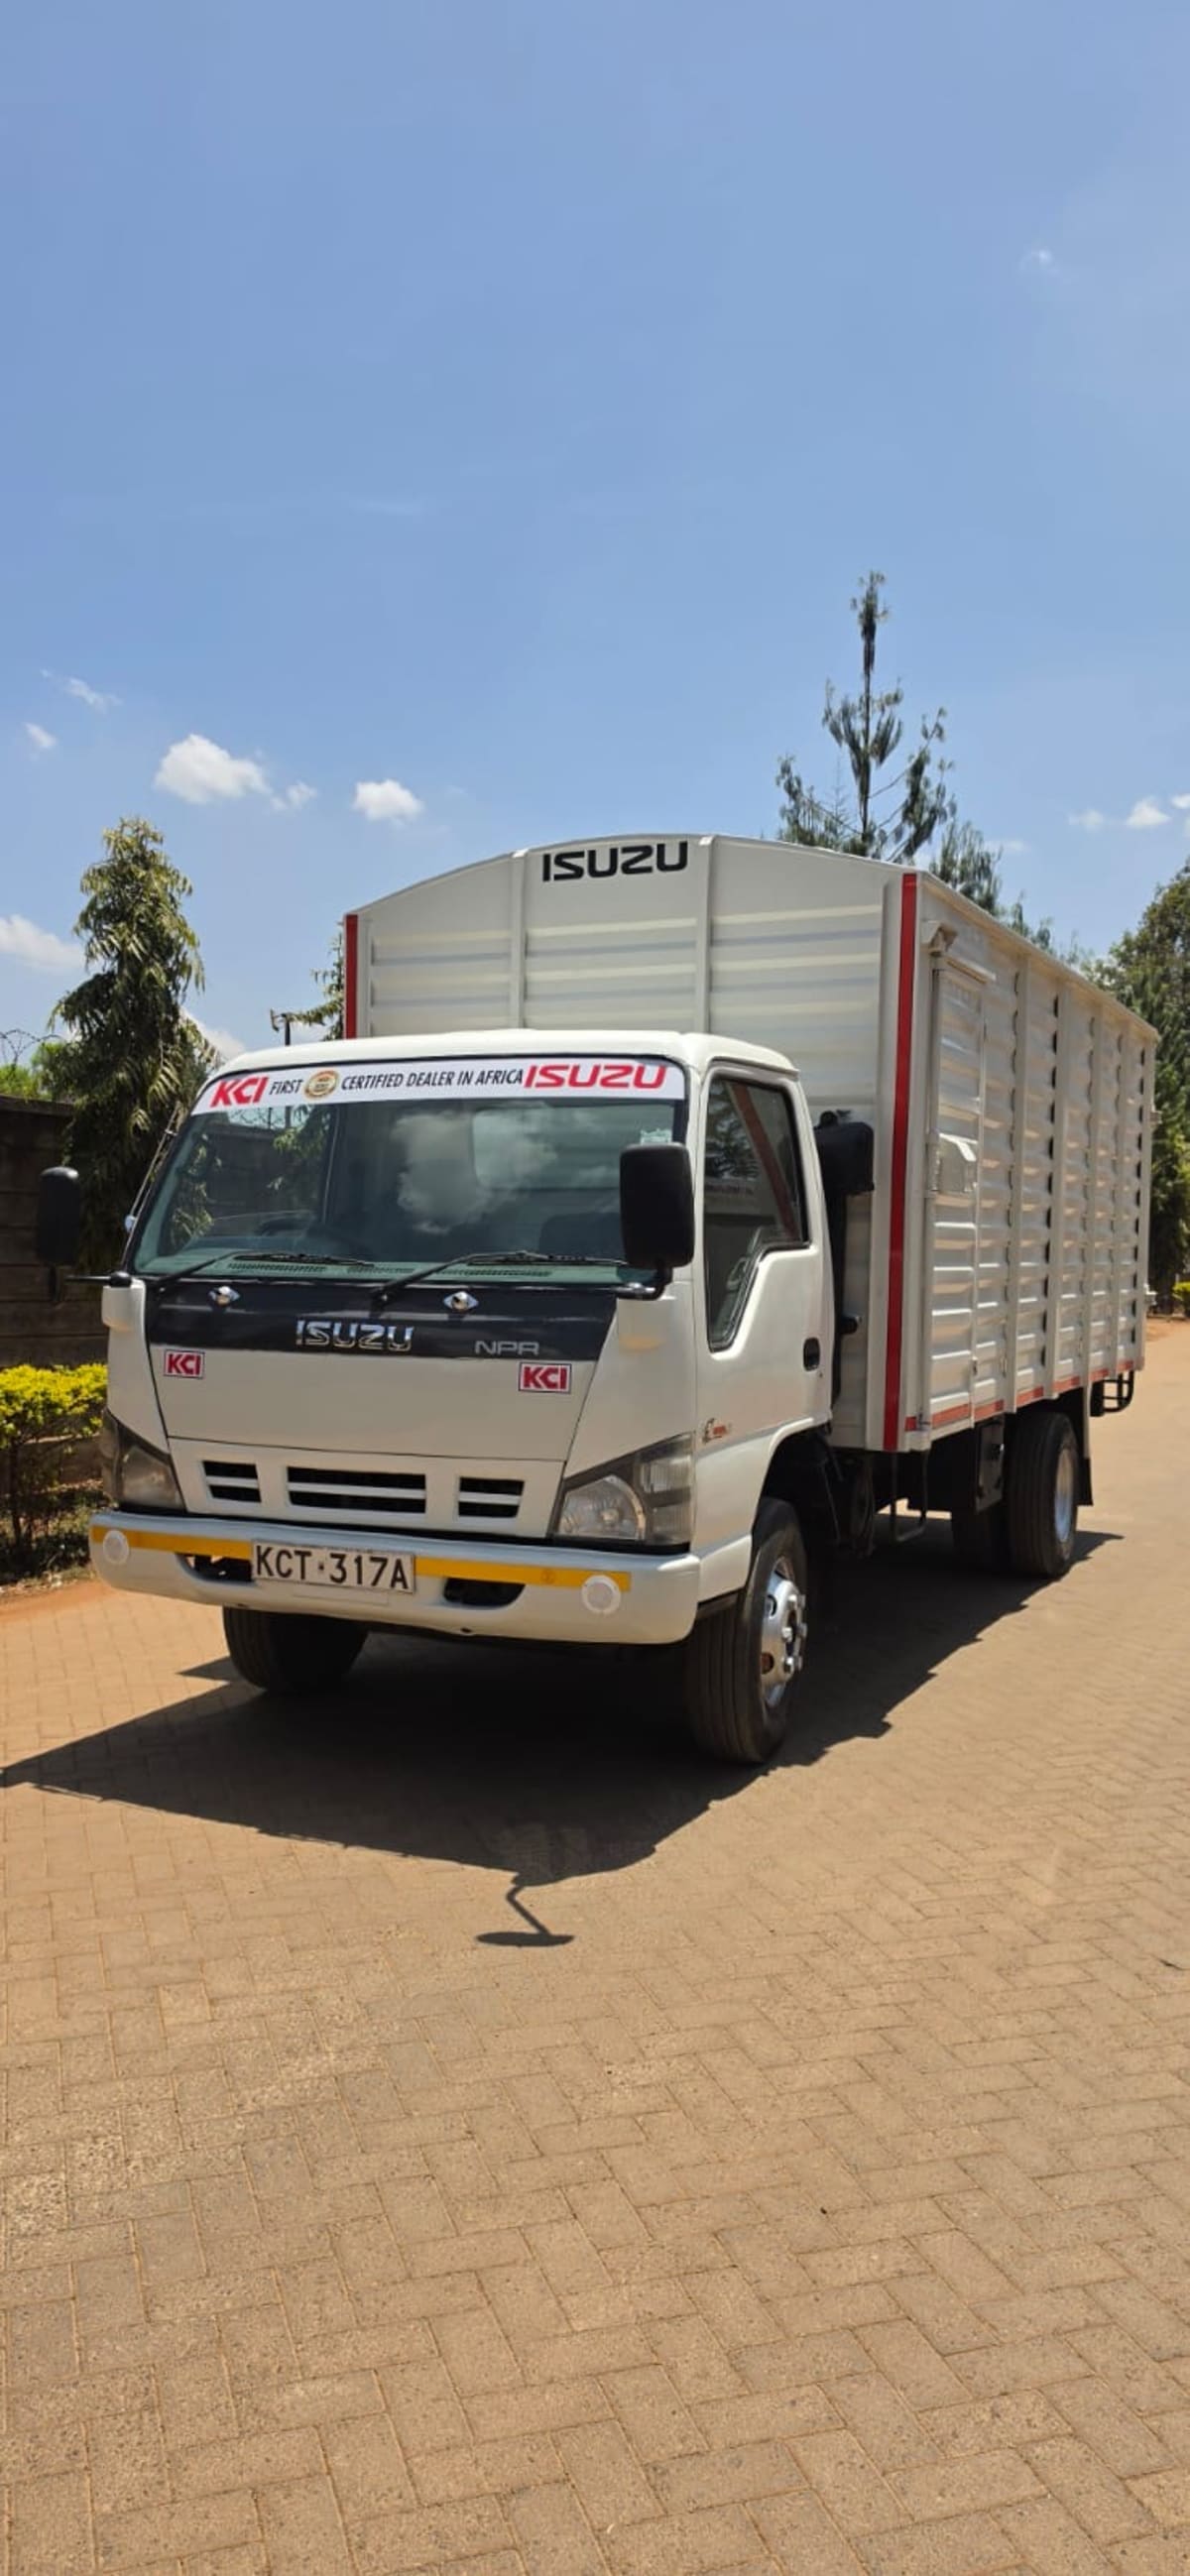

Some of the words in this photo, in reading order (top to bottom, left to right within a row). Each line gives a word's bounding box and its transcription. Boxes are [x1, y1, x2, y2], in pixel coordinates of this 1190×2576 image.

[542, 841, 688, 882] ISUZU
[210, 1075, 269, 1108] KCI
[269, 1079, 303, 1095] FIRST
[341, 1073, 404, 1091] CERTIFIED
[406, 1070, 453, 1088] DEALER
[457, 1070, 474, 1086] IN
[475, 1069, 524, 1086] AFRICA
[524, 1065, 667, 1089] ISUZU
[296, 1320, 415, 1351] ISUZU
[475, 1341, 539, 1355] NPR
[168, 1352, 201, 1376] KCI
[523, 1366, 567, 1389] KCI
